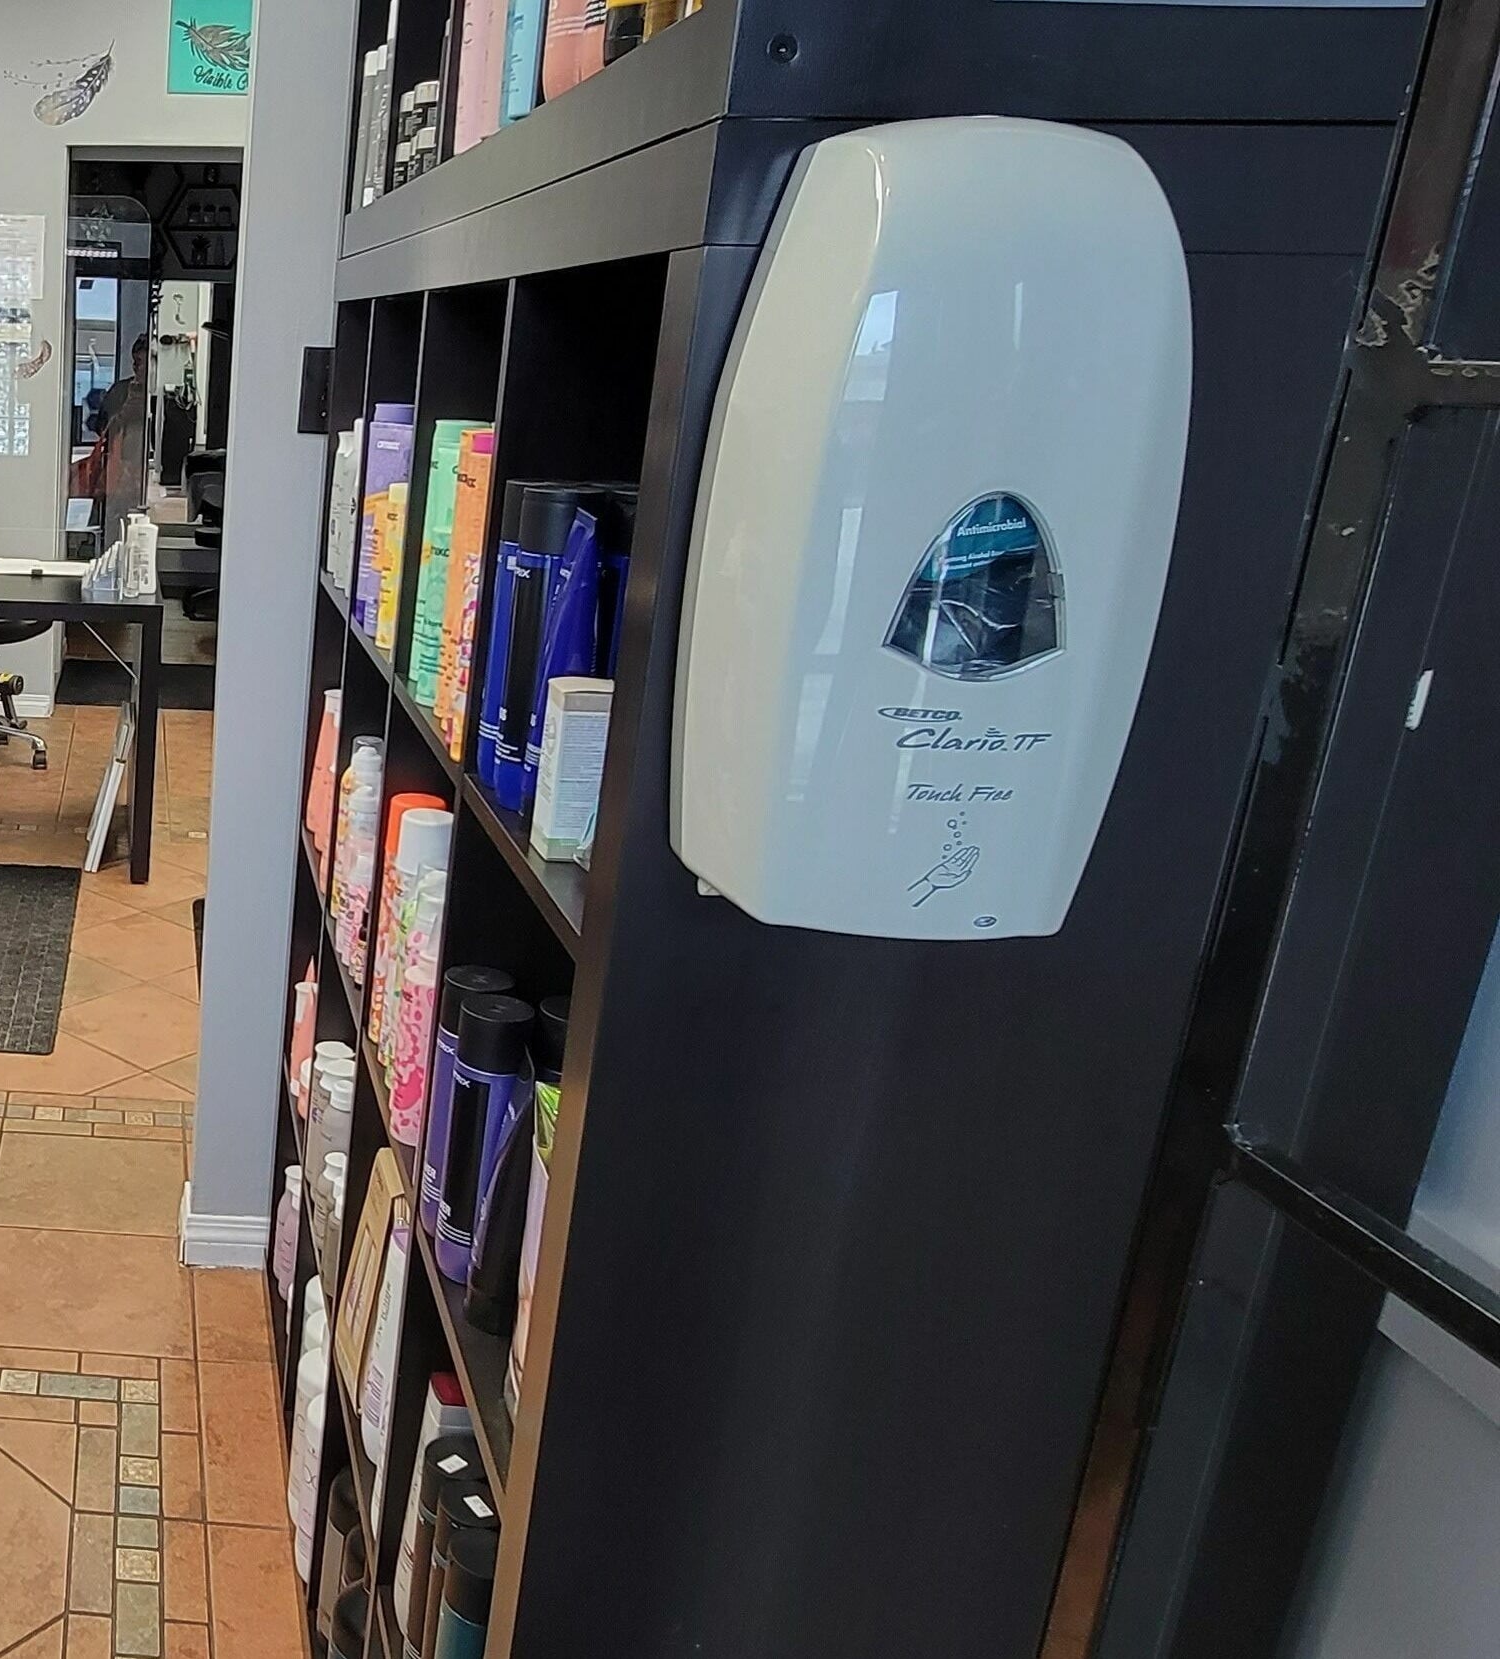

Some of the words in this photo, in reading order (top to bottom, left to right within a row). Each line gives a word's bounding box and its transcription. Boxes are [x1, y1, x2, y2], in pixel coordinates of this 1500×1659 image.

[956, 517, 1028, 538] Antimicrobial
[1013, 733, 1053, 751] TF
[907, 784, 963, 801] Touch
[968, 786, 1014, 801] Free
